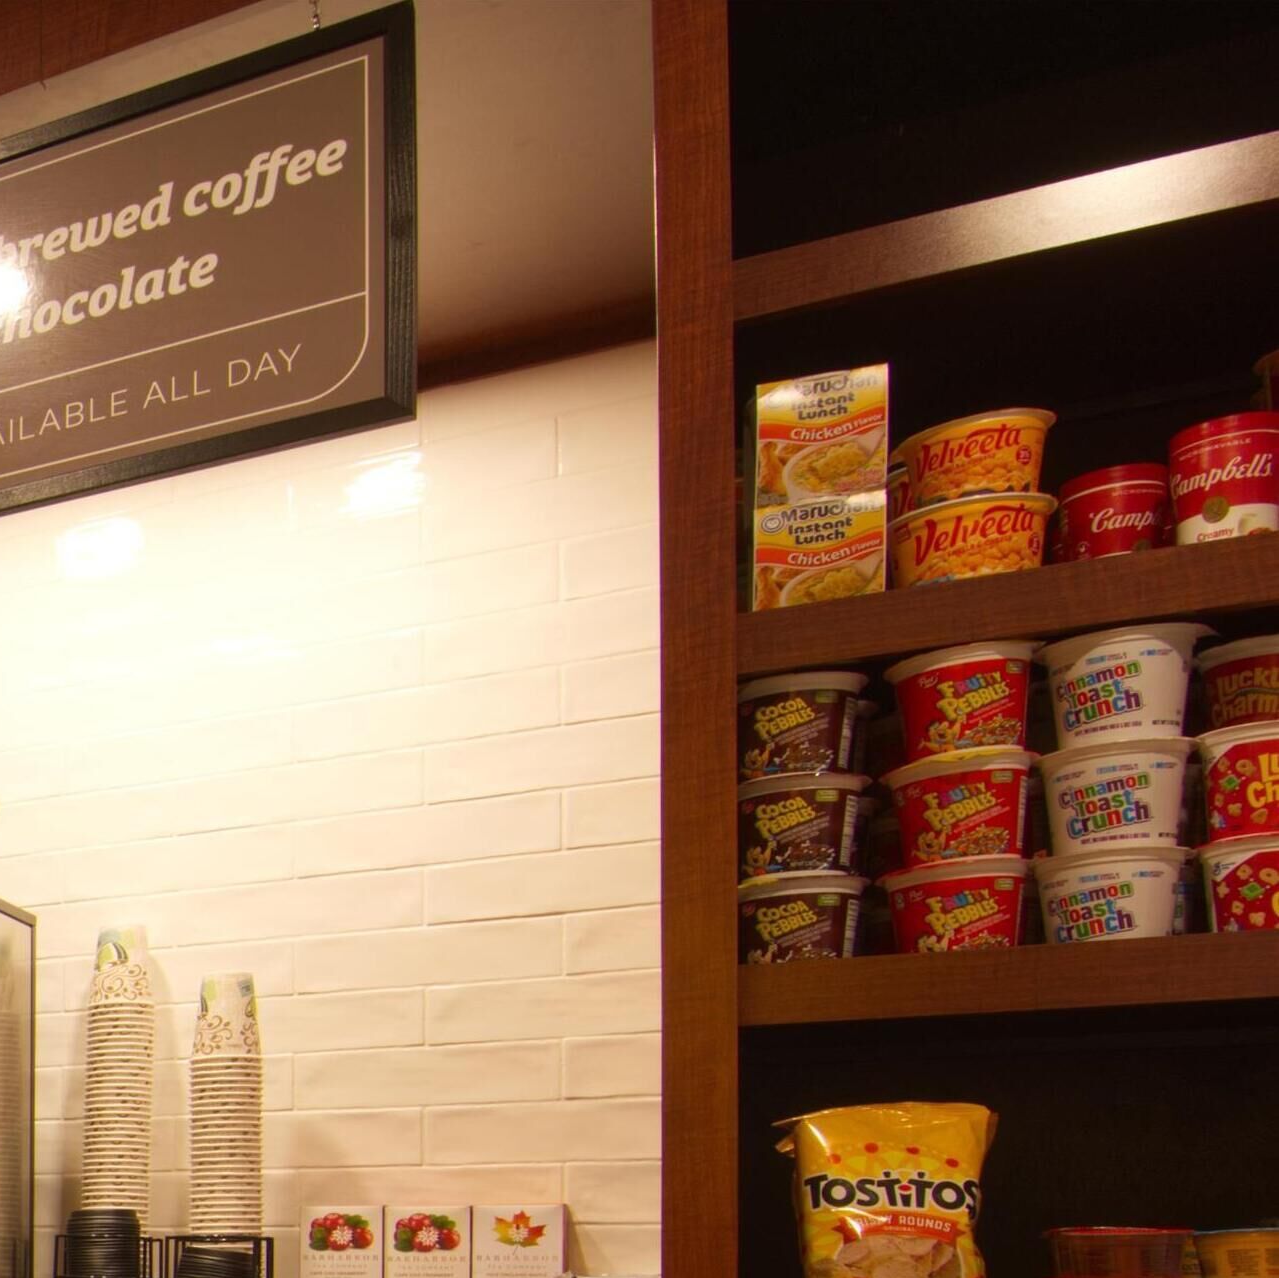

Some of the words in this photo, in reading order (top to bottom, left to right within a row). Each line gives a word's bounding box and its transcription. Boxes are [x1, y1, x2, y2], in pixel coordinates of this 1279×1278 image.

[183, 138, 348, 218] coffee
[143, 374, 210, 410] ALL
[227, 343, 304, 389] DAY
[789, 421, 853, 442] Chicken
[852, 413, 885, 428] Flavor
[797, 404, 849, 421] Lunch
[916, 423, 1022, 482] Velveeta
[1170, 453, 1274, 499] Campbell's
[788, 516, 853, 535] Instant
[794, 529, 846, 545] Lunch
[914, 504, 1037, 566] Velveeta
[787, 546, 852, 566] Chicken
[851, 536, 883, 553] Flavor
[804, 1171, 980, 1214] TOSTITOS
[898, 1215, 952, 1233] ROUNDS
